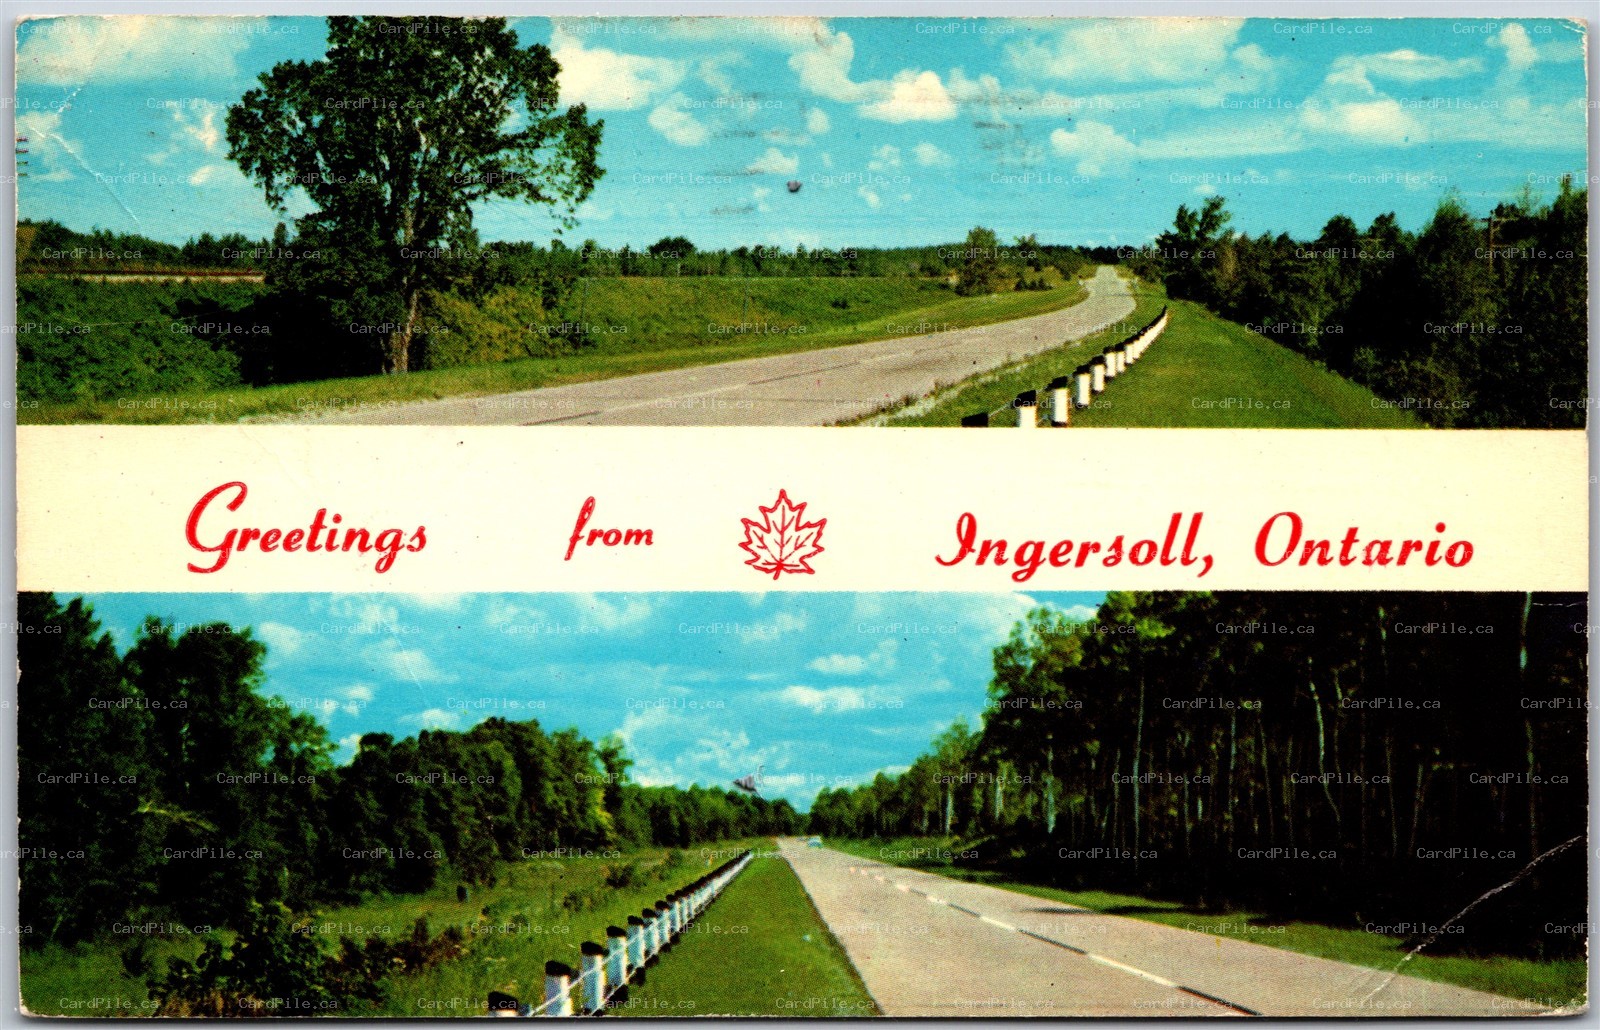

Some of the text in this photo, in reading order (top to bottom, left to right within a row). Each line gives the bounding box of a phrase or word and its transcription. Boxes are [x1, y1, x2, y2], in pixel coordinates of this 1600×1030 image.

[184, 481, 654, 574] Greetings from
[935, 511, 1475, 582] Ingersoll, Ontario
